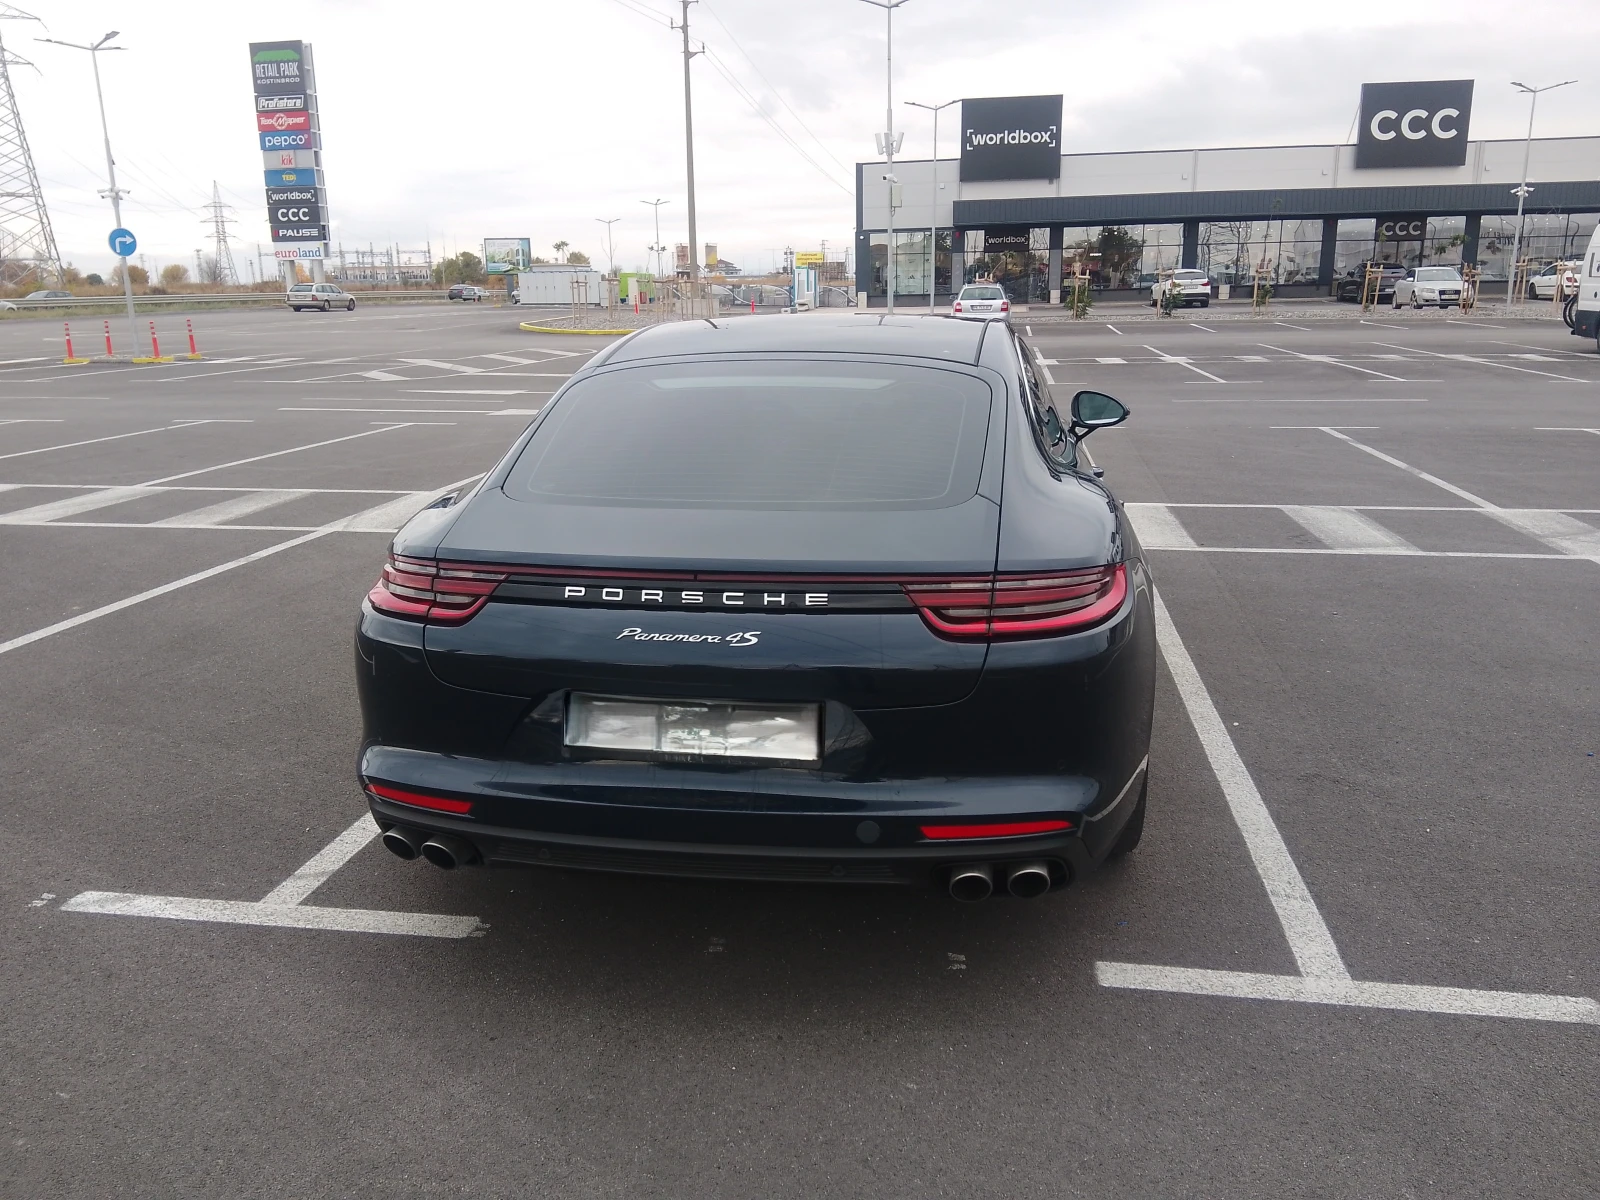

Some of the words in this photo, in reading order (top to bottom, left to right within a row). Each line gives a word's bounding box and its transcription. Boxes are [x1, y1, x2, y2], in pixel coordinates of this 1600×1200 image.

[255, 63, 280, 78] RETAIL
[280, 62, 300, 76] PARK
[257, 77, 300, 85] KOSTINBROD
[1370, 107, 1461, 141] CCC
[265, 135, 305, 148] pepco
[971, 129, 1052, 146] worldbox
[270, 190, 313, 201] worldbox
[277, 208, 310, 221] CCC
[279, 228, 319, 237] PAUSE
[1381, 221, 1422, 236] CCC
[988, 235, 1026, 244] worldbox
[274, 247, 322, 259] euroland
[564, 586, 829, 607] PORSCHE
[616, 627, 721, 644] Panamera
[725, 631, 762, 647] 4S
